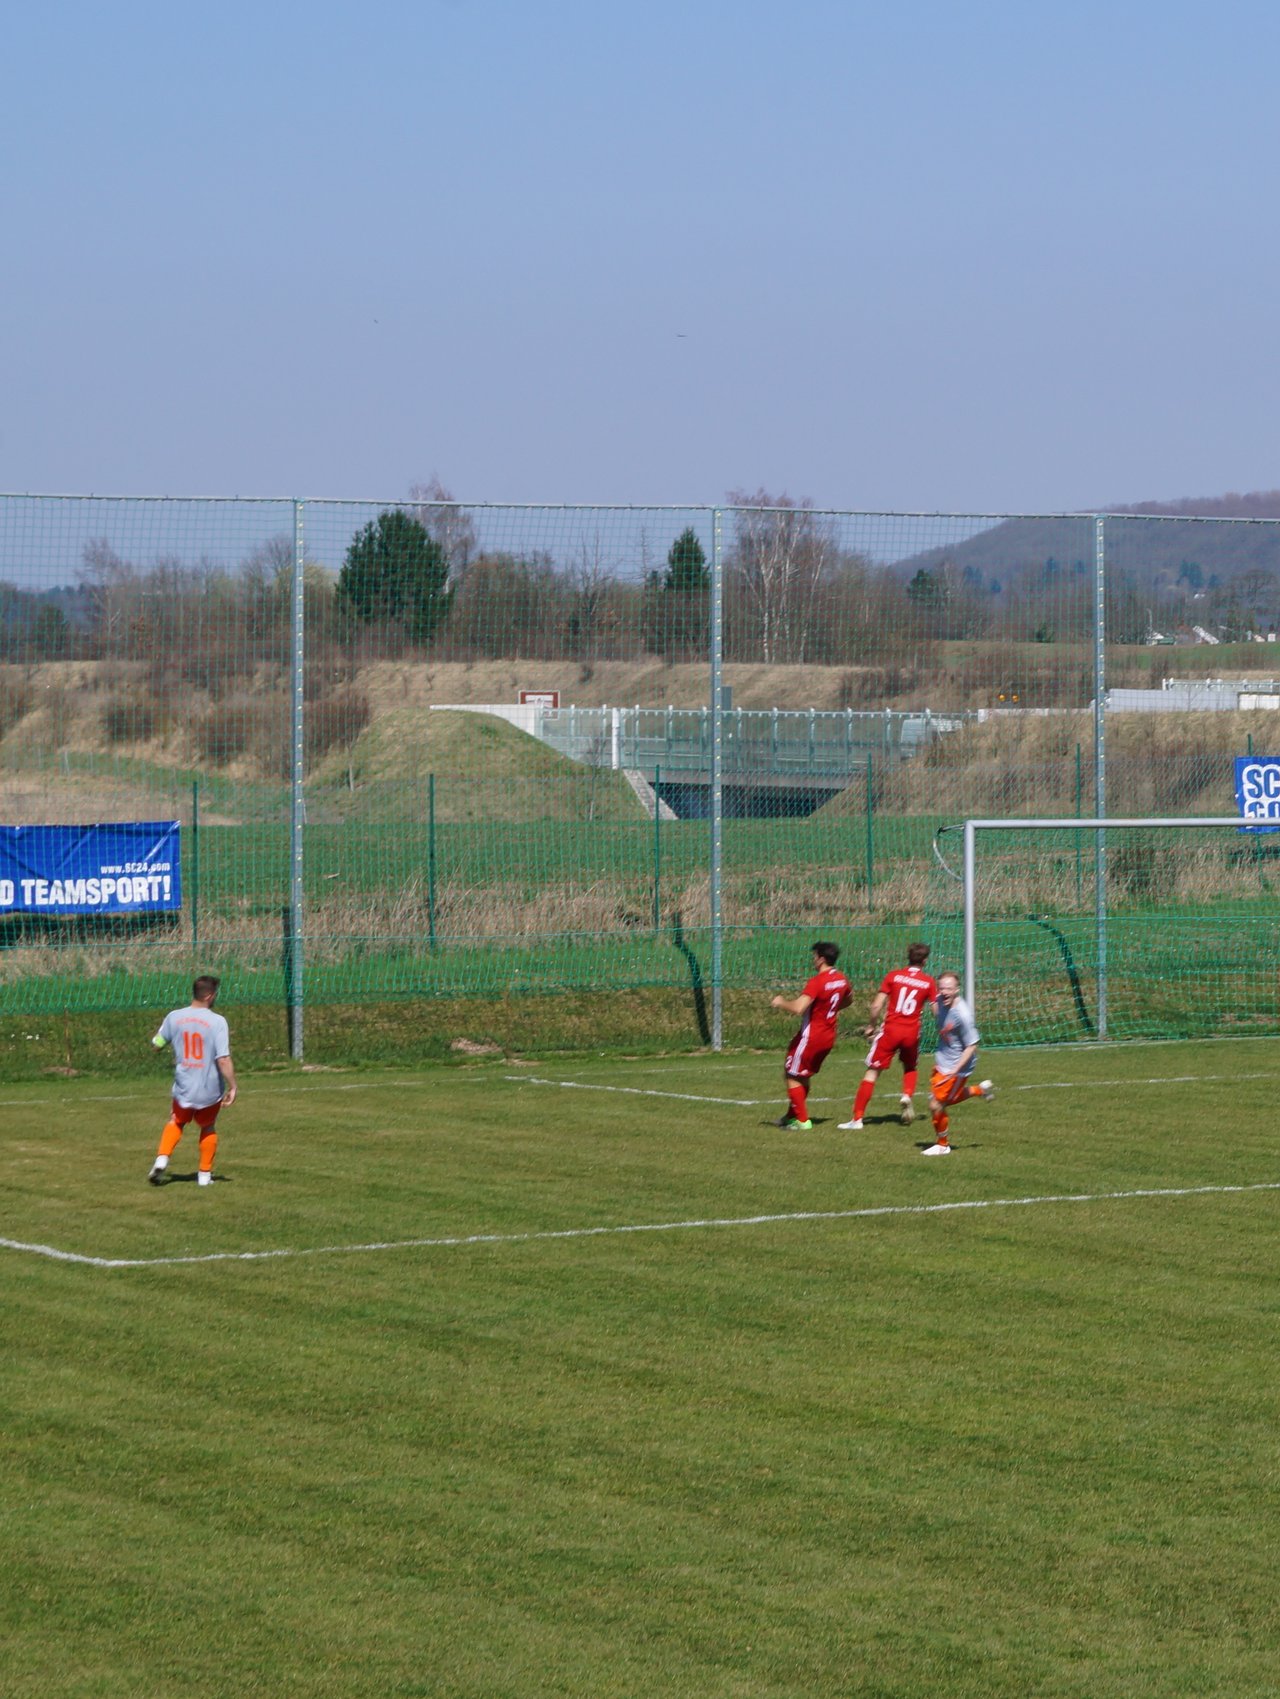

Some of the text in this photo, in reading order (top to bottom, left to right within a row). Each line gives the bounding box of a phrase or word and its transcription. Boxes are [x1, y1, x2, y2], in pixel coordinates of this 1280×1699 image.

[20, 875, 171, 906] TEAMSPORT!
[826, 992, 840, 1020] 2
[894, 986, 919, 1016] 16
[183, 1030, 203, 1060] 10
